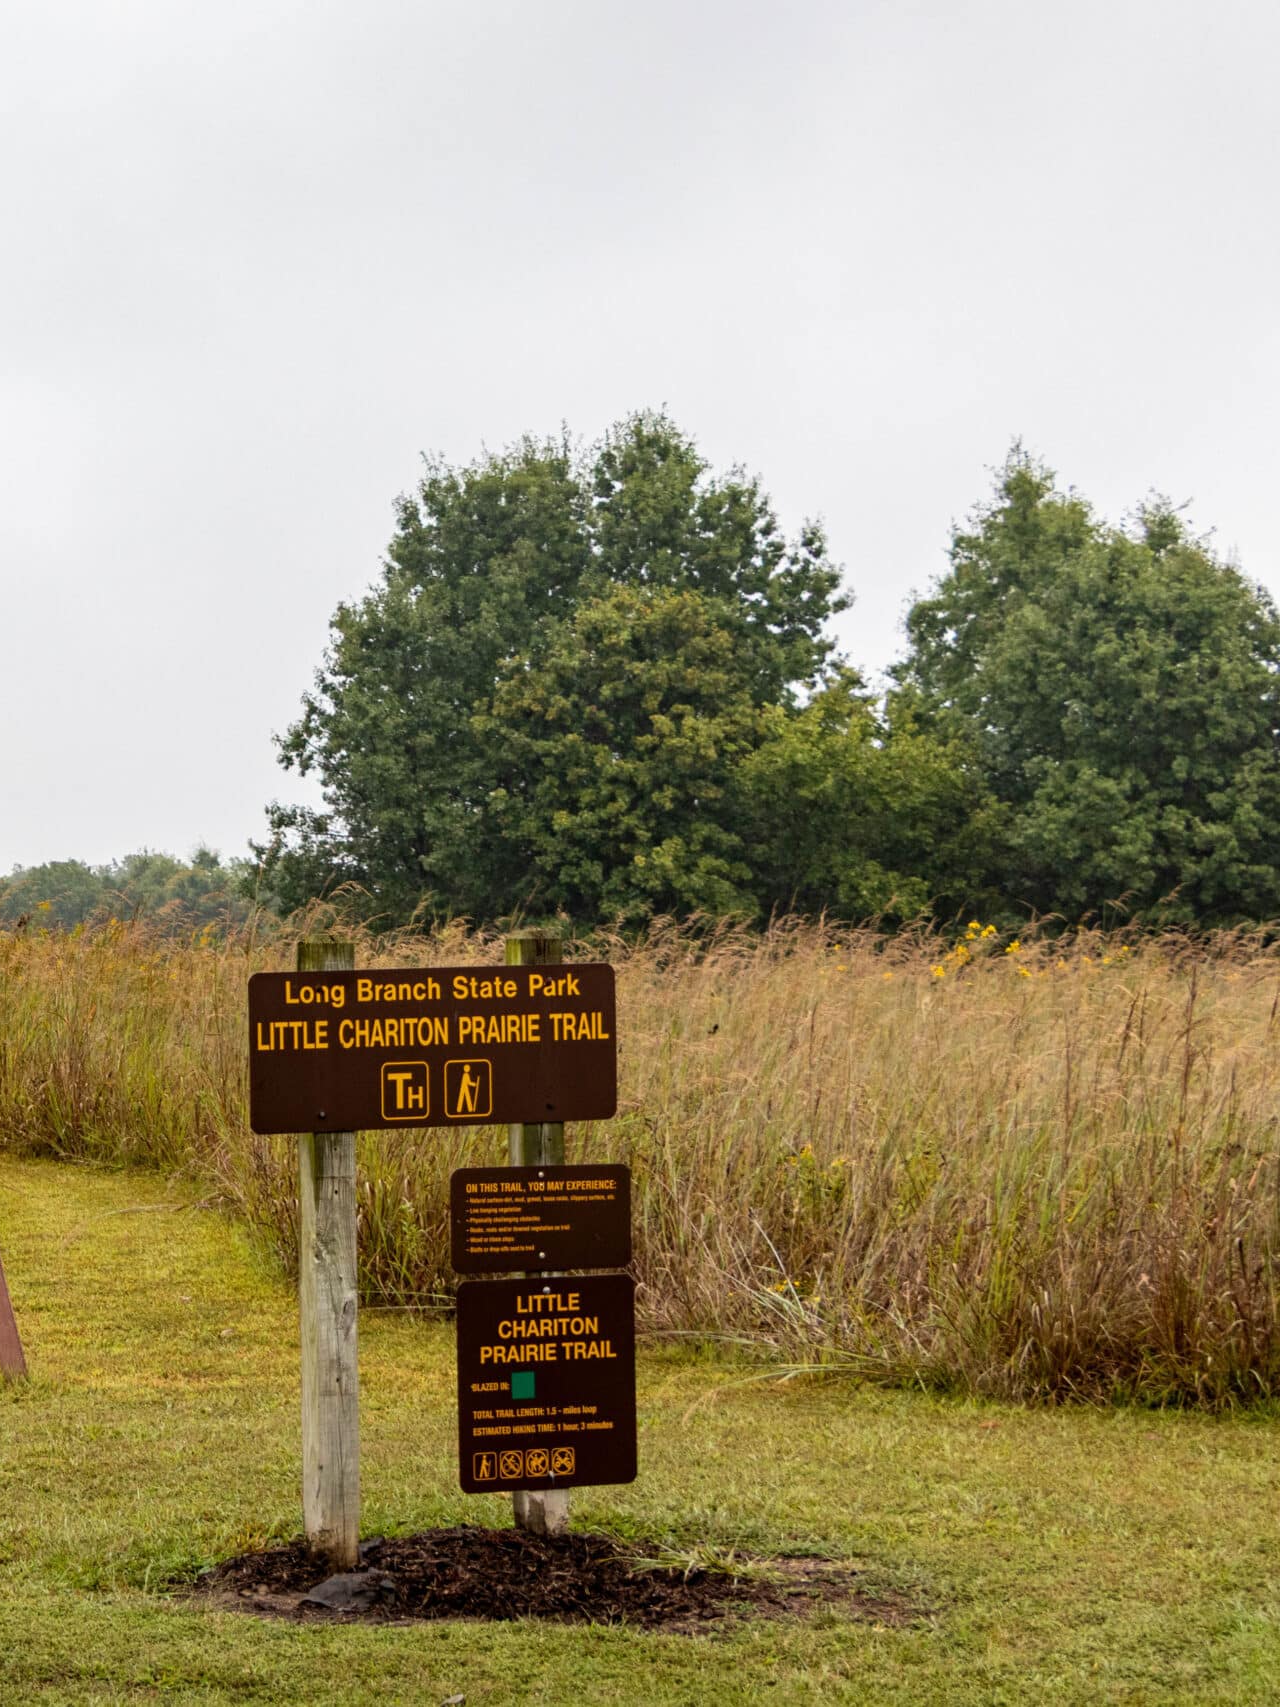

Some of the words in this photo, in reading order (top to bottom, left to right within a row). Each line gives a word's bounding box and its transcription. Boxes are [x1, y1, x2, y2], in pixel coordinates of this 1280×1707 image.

[285, 980, 345, 1008] Long
[356, 976, 441, 1003] Branch
[452, 974, 518, 1000] State
[528, 972, 580, 997] Park
[257, 1020, 329, 1052] LITTLE
[338, 1016, 449, 1049] CHARITON
[458, 1013, 541, 1045] PRAIRIE
[549, 1011, 610, 1041] TRAIL
[466, 1183, 478, 1193] ON
[479, 1183, 499, 1193] THIS
[528, 1181, 545, 1192] YOU
[547, 1180, 565, 1191] MAY
[566, 1179, 616, 1191] EXPERIENCE:
[516, 1292, 581, 1314] LITTLE
[497, 1316, 599, 1339] CHARITON
[480, 1343, 557, 1364] PRAIRIE
[562, 1340, 617, 1360] TRAIL
[472, 1382, 499, 1392] BLAZED
[473, 1410, 495, 1420] TOTAL
[496, 1409, 515, 1418] TRAIL
[516, 1407, 545, 1417] LENGTH:
[546, 1406, 557, 1415] 1.5
[562, 1405, 581, 1414] miles
[582, 1405, 597, 1415] loop
[473, 1426, 511, 1437] ESTIMATED
[512, 1424, 536, 1434] HIKING
